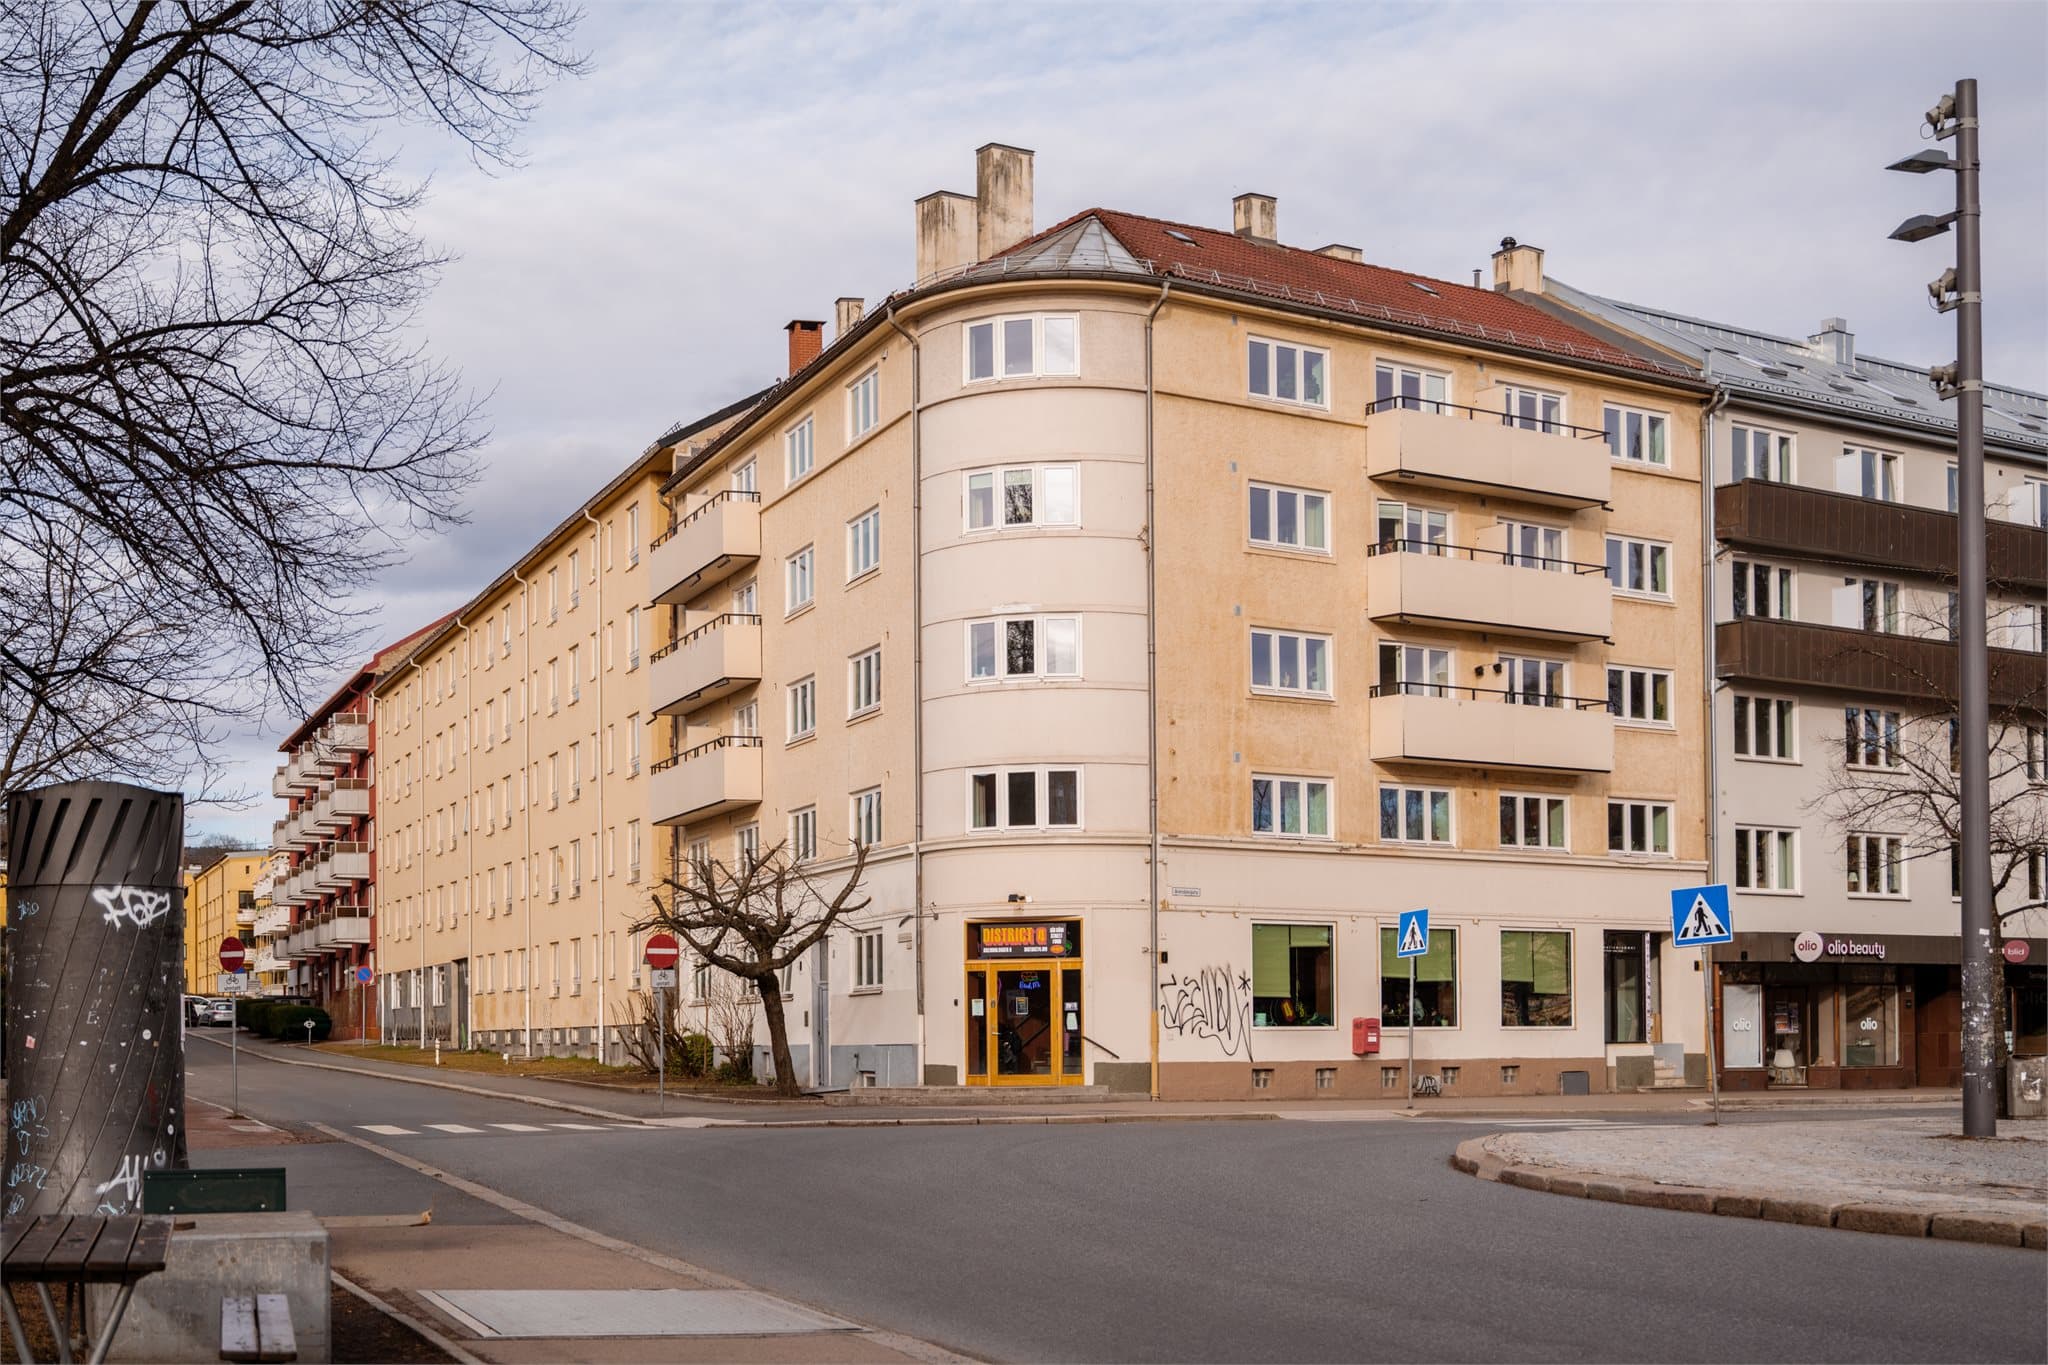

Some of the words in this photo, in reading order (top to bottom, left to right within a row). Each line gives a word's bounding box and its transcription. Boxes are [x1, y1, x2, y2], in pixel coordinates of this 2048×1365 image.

[983, 927, 1034, 945] DISTRICT
[1798, 940, 1818, 951] olio
[1828, 940, 1848, 955] olio
[1849, 940, 1885, 959] beauty
[1733, 1018, 1752, 1032] olio
[1860, 1017, 1878, 1030] olio
